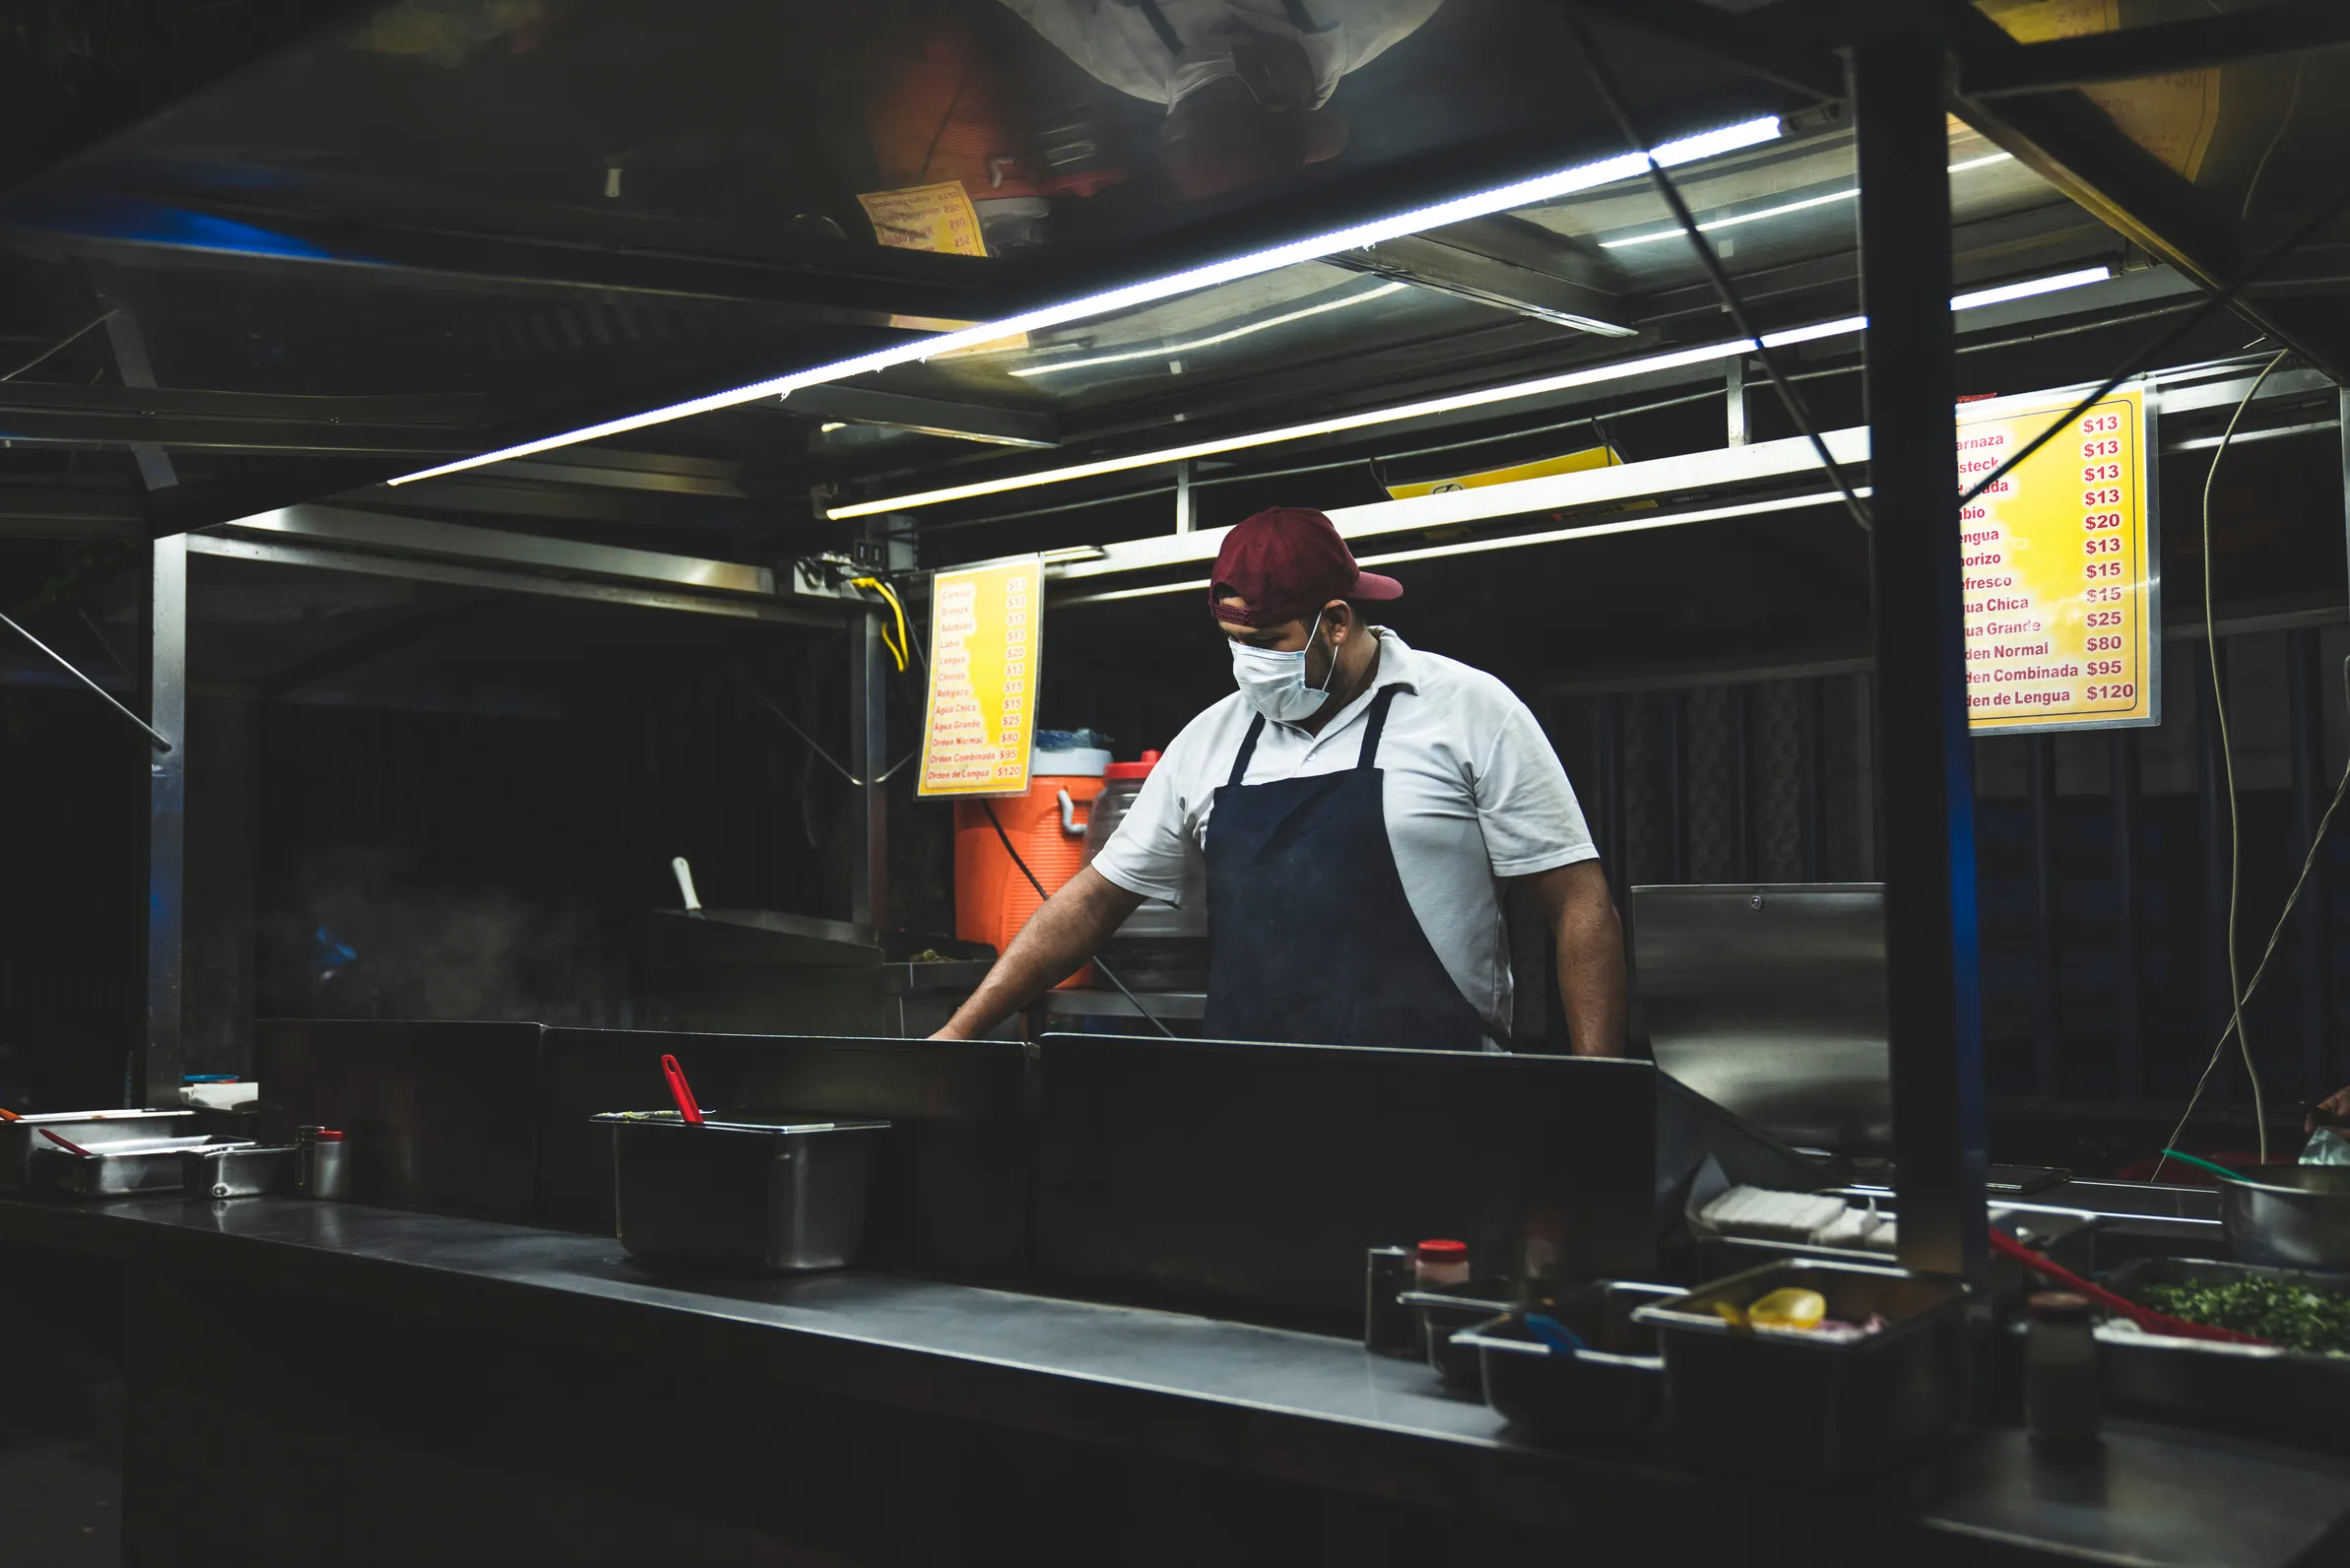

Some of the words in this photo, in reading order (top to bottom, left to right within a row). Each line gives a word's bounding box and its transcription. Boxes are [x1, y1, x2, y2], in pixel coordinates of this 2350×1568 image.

[1956, 435, 2004, 451] arnaza
[2083, 416, 2119, 433] $13
[2084, 440, 2119, 458] $13
[2084, 464, 2120, 482] $13
[2085, 489, 2121, 506] $13
[2085, 513, 2121, 531] $20
[2086, 538, 2121, 555] $13
[2086, 562, 2121, 579] $15
[1009, 579, 1026, 591] $13
[1008, 597, 1025, 608] $13
[1987, 597, 2029, 612] Chica
[2086, 586, 2122, 604] $15
[1008, 614, 1025, 624] $13
[2087, 612, 2122, 627] $25
[1008, 630, 1024, 641] $13
[1008, 647, 1024, 658] $20
[1994, 642, 2049, 659] Normal
[2087, 636, 2122, 652] $80
[1006, 665, 1023, 676] $13
[1994, 666, 2078, 682] Combinada
[2087, 661, 2122, 677] $95
[1005, 682, 1022, 692] $15
[1993, 692, 2011, 705] de
[2014, 689, 2070, 706] Lengua
[2087, 684, 2134, 700] $120
[1004, 698, 1021, 709] $15
[1002, 715, 1020, 726] $25
[1001, 733, 1018, 743] $80
[999, 750, 1017, 760] $95
[997, 765, 1020, 777] $120
